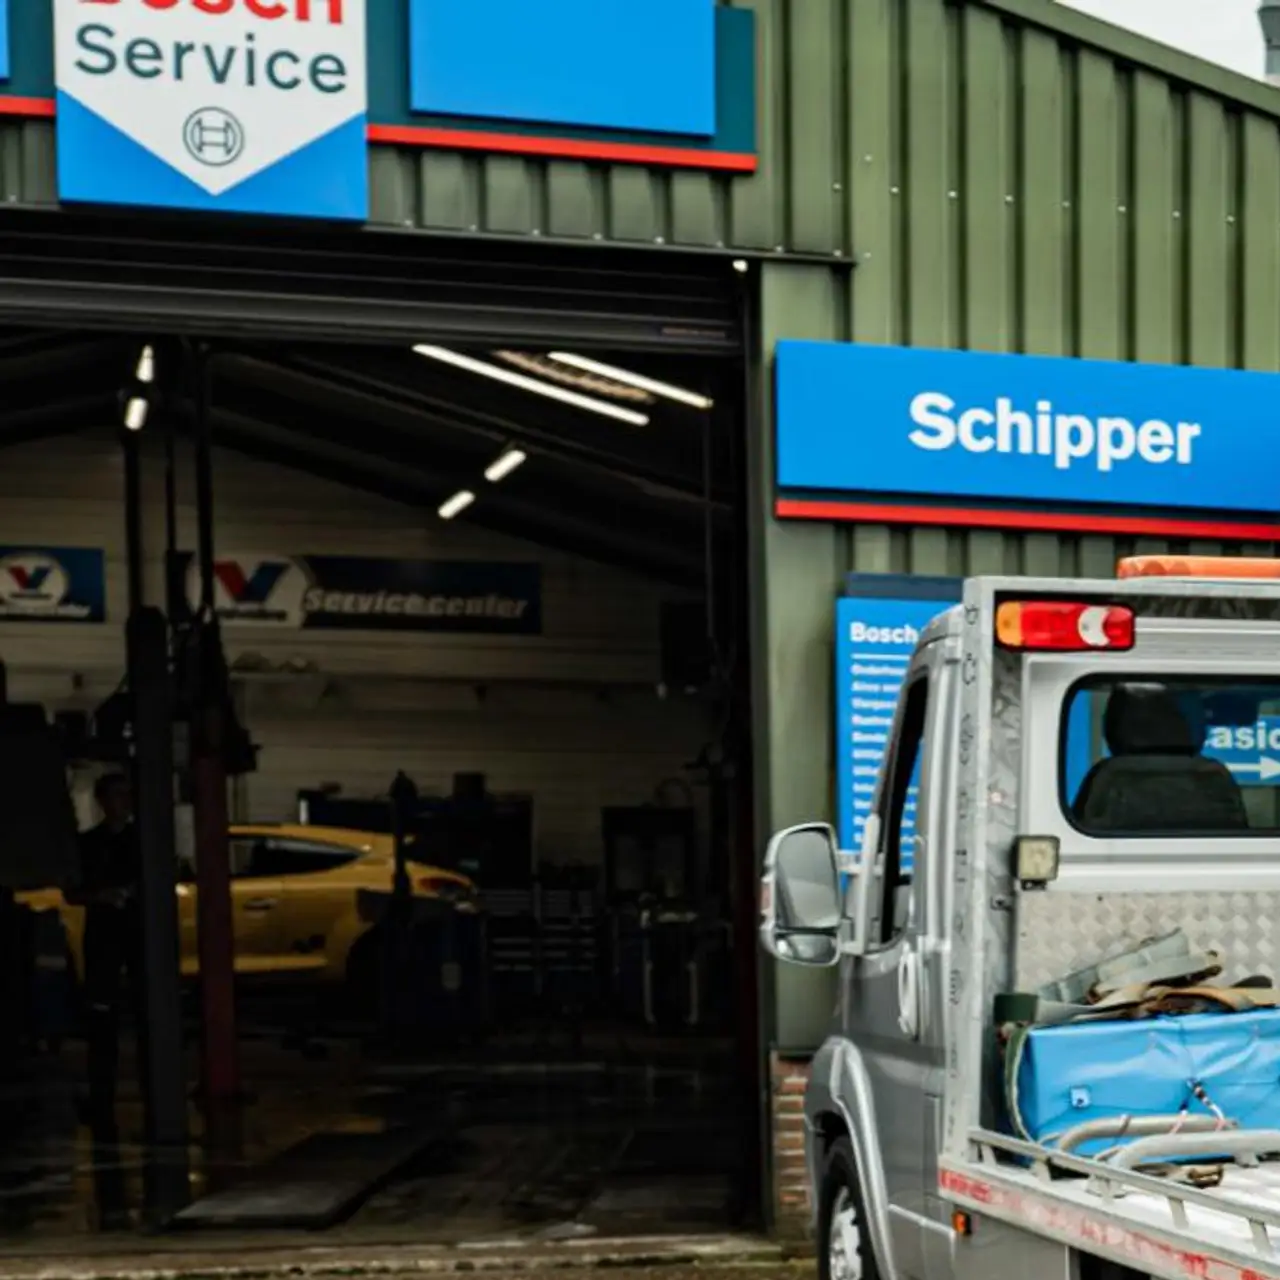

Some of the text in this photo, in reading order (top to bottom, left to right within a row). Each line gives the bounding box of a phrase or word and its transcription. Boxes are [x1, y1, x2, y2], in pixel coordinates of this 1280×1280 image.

[74, 23, 347, 94] Service
[908, 391, 1202, 472] Schipper
[849, 621, 918, 644] Bosch
